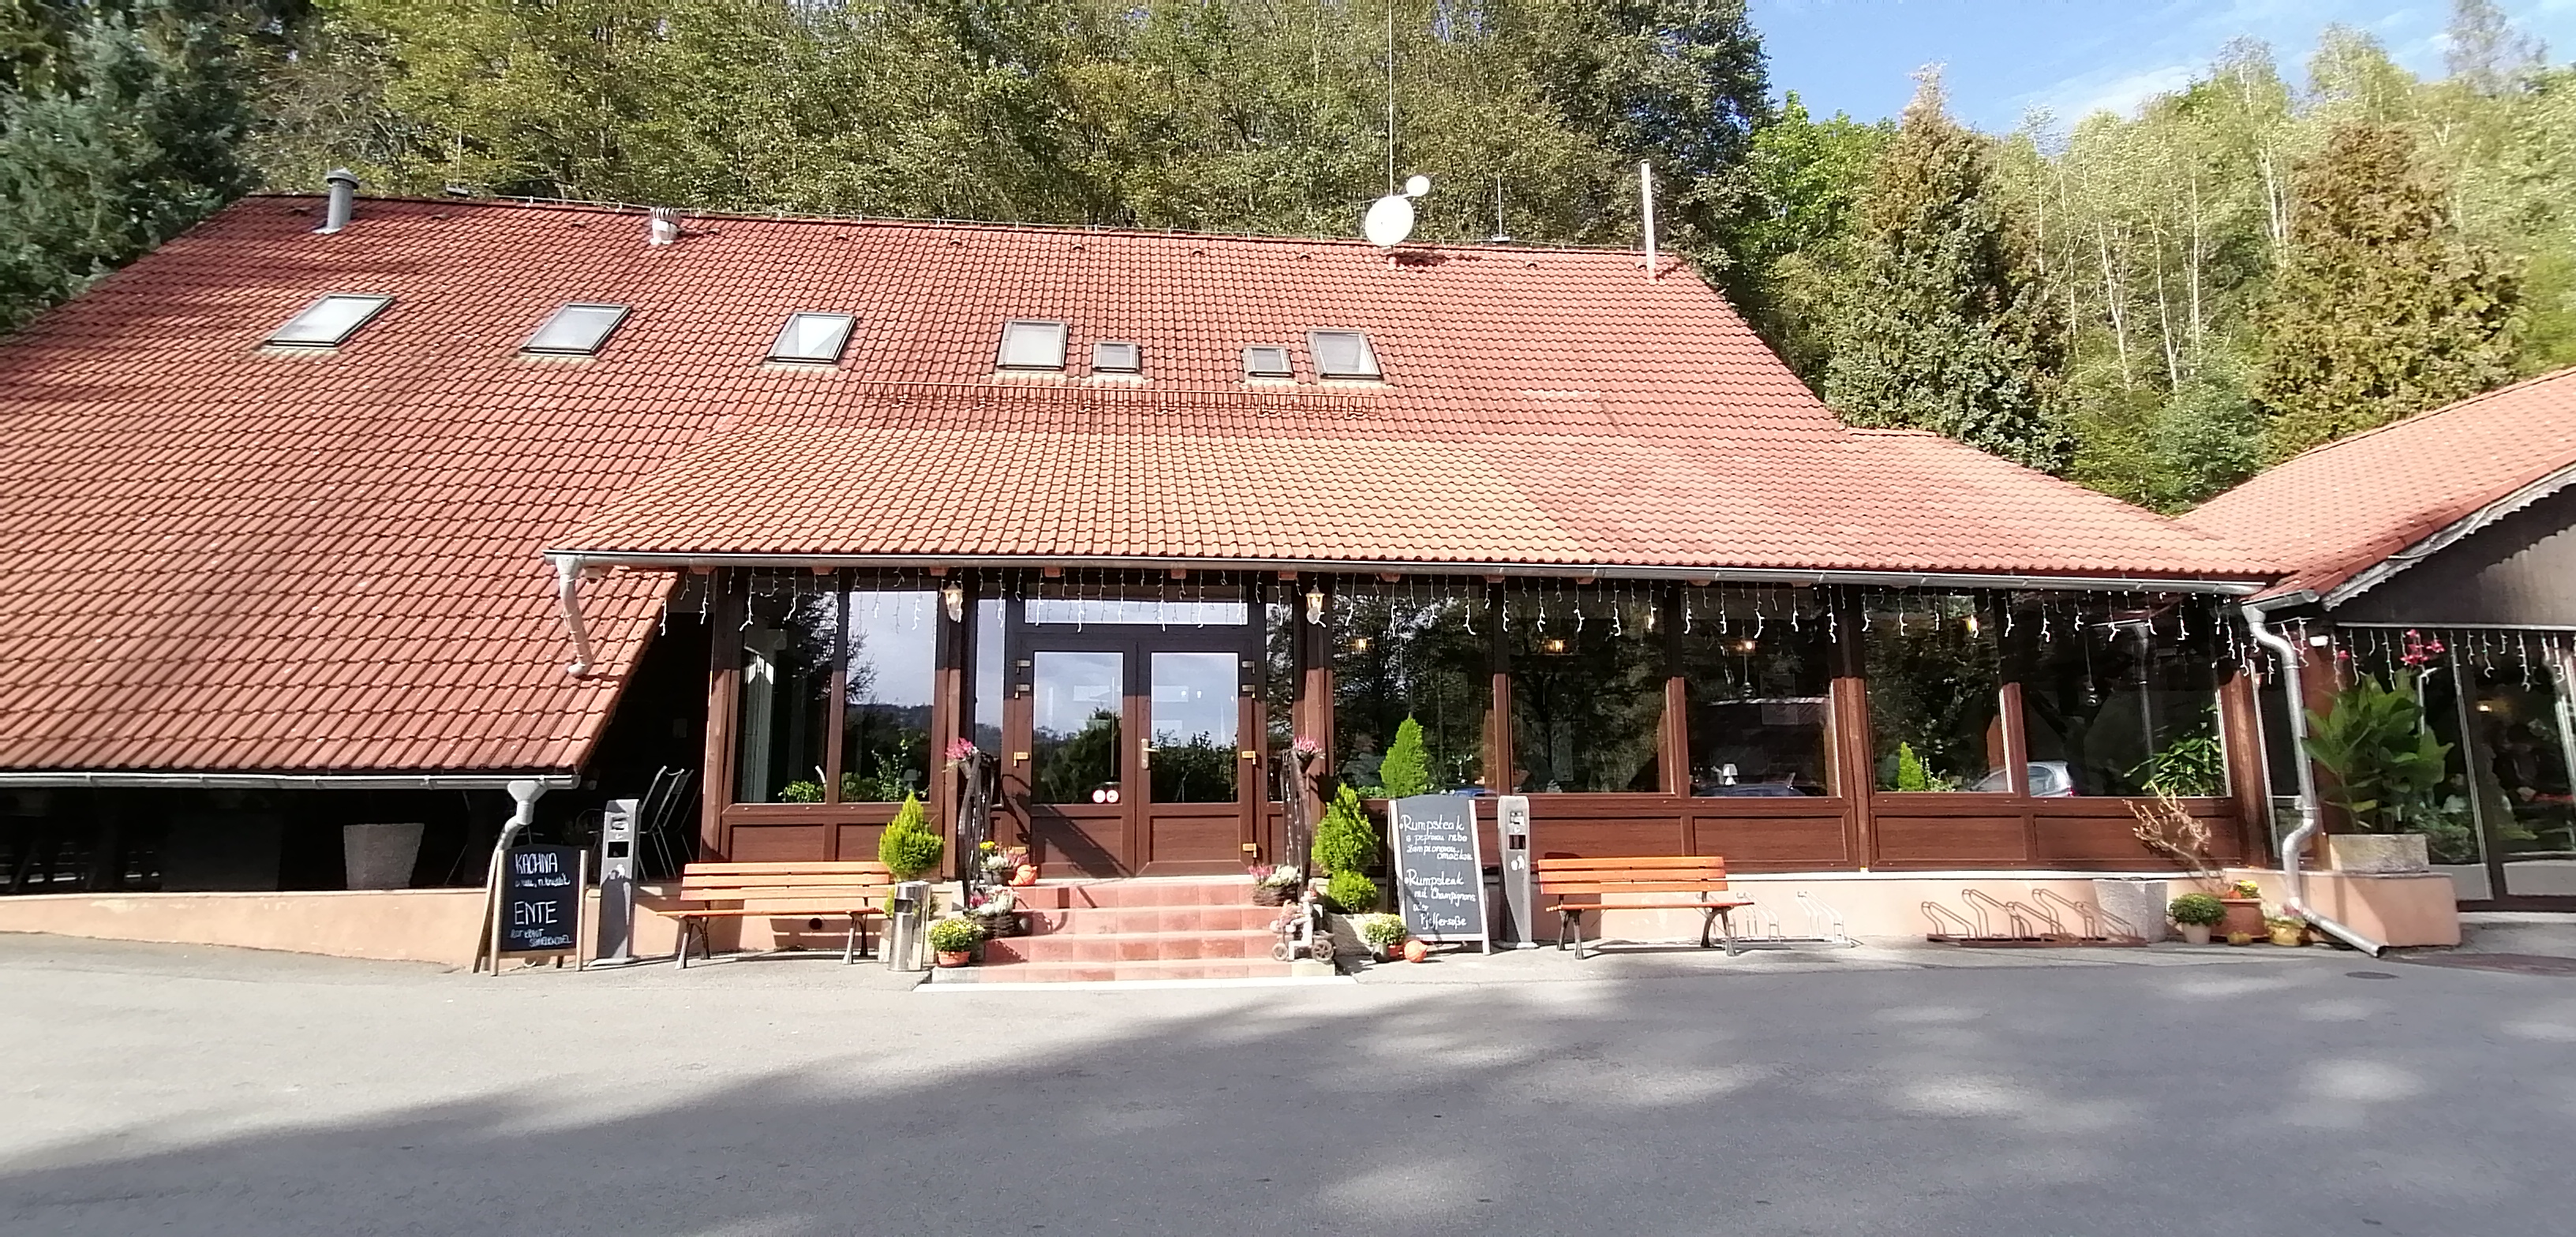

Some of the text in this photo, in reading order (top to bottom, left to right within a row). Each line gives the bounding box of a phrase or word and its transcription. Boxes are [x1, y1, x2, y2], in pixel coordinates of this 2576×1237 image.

[1400, 814, 1465, 835] Rumpsteak
[1447, 832, 1468, 843] nebo
[515, 853, 558, 874] KACHNA
[1406, 869, 1465, 891] Rumpsteak
[1431, 887, 1476, 907] Champignons
[515, 901, 558, 925] ENTE
